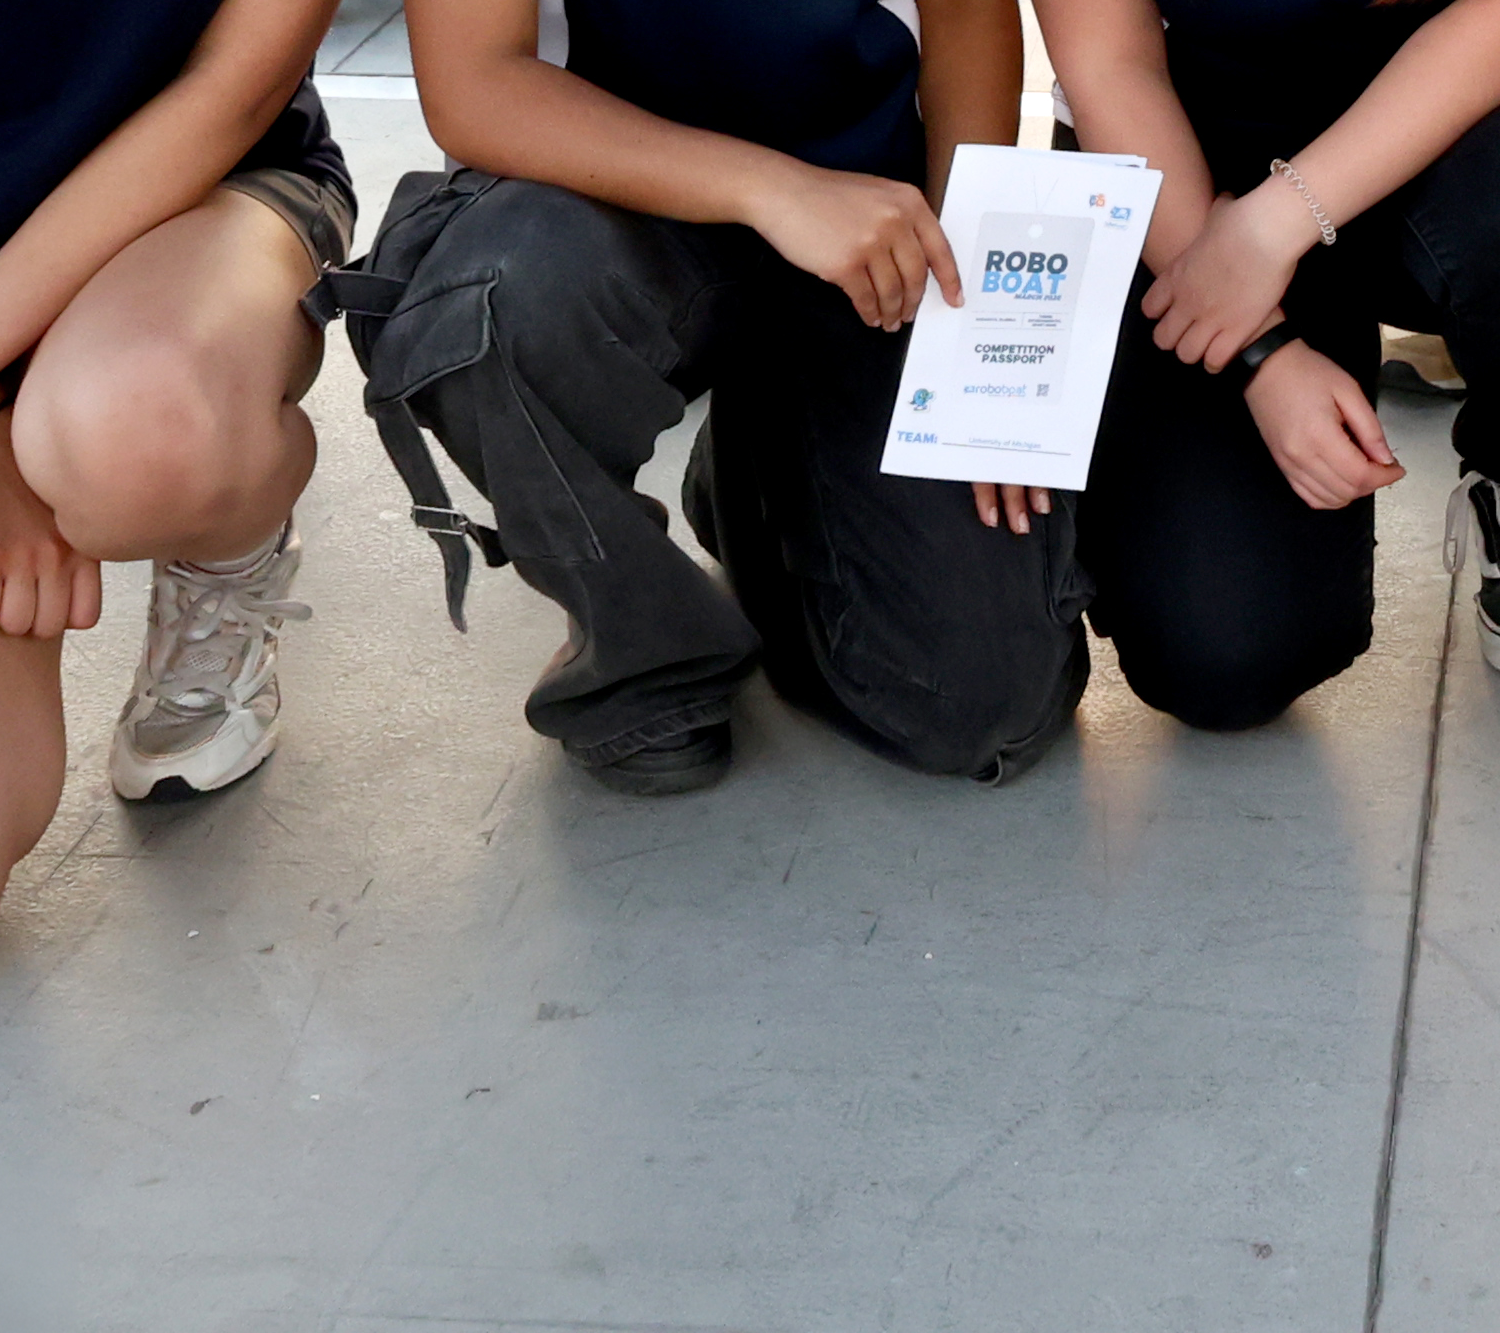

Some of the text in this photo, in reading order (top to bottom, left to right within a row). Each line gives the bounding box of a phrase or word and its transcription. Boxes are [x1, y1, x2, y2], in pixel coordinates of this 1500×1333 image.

[985, 250, 1068, 274] ROBO
[982, 271, 1067, 294] BOAT
[974, 344, 1055, 355] COMPETITION
[981, 354, 1045, 364] PASSPORT
[973, 384, 1027, 395] roboboat
[897, 431, 938, 444] TEAM:
